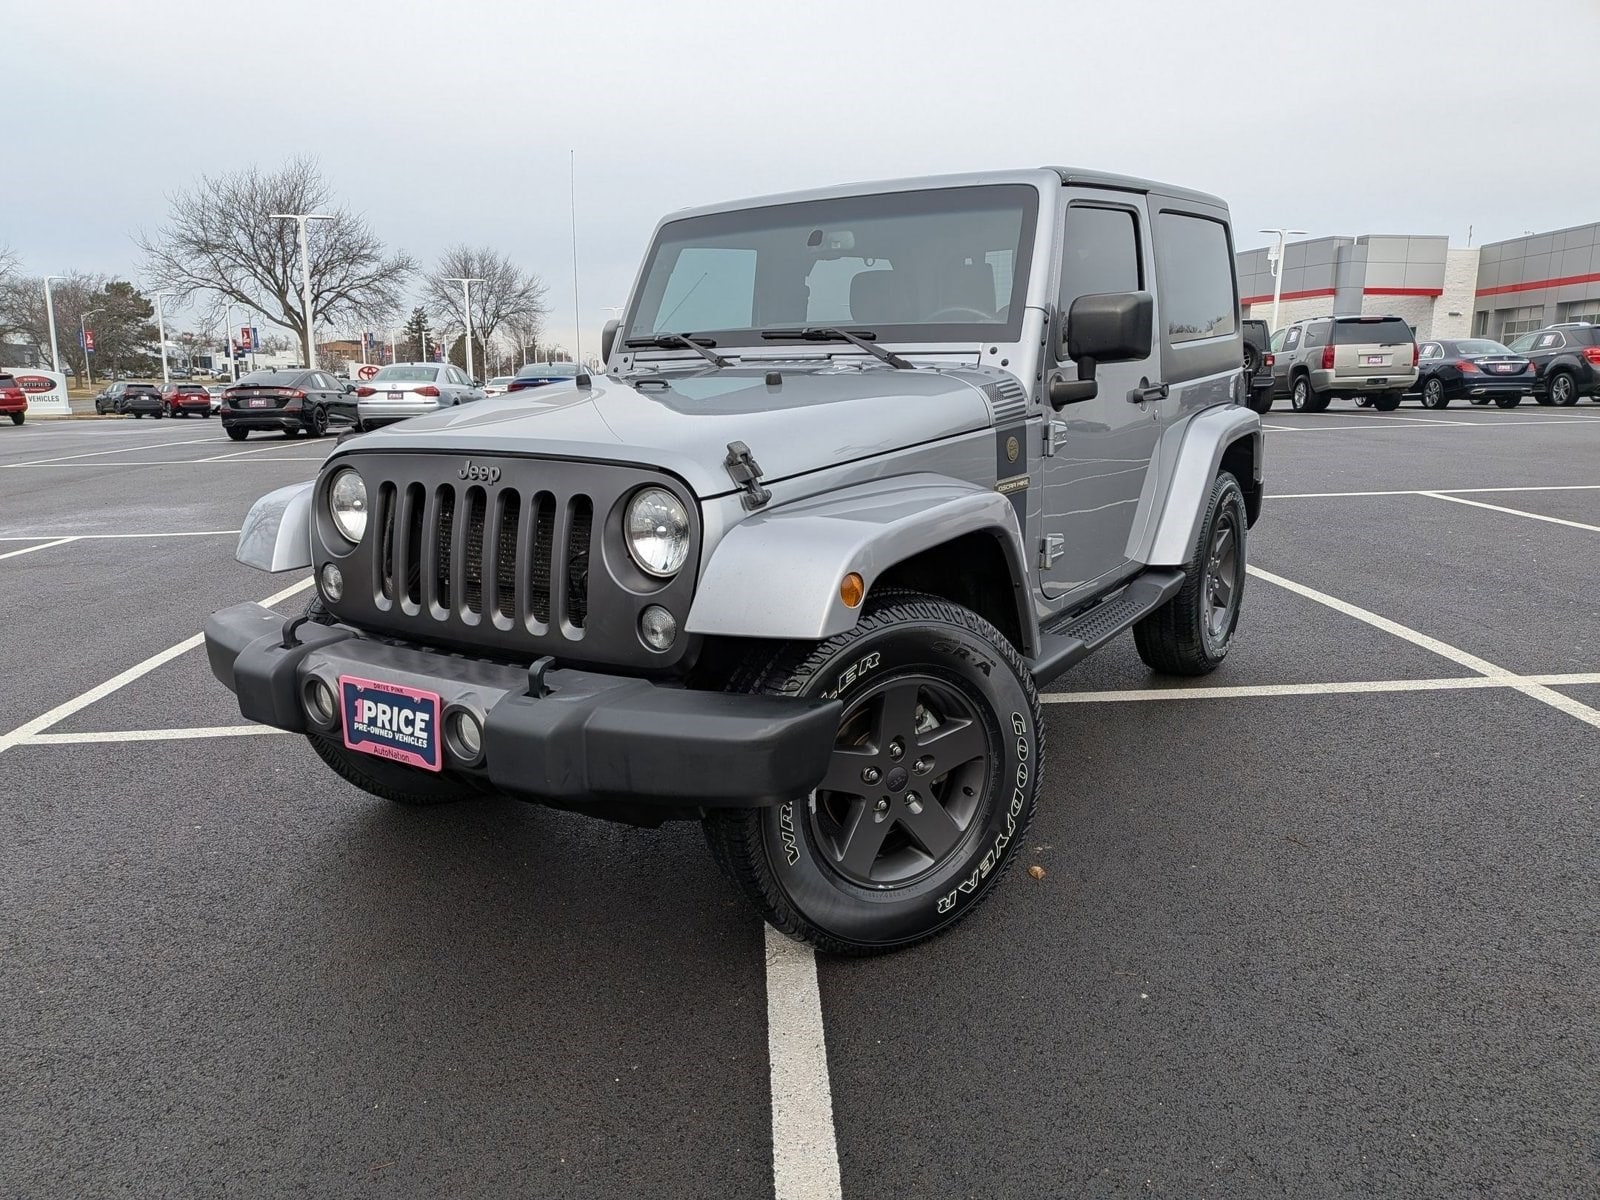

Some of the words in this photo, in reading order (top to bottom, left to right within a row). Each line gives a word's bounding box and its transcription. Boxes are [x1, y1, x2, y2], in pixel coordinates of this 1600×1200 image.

[457, 460, 501, 486] Jeep
[373, 683, 390, 691] DRIVE
[354, 699, 430, 738] 1PRICE
[354, 723, 393, 739] PRE-OWNED
[394, 733, 428, 748] VEHICLES
[373, 746, 410, 762] AutoNation
[938, 711, 1029, 914] GOODYEAR
